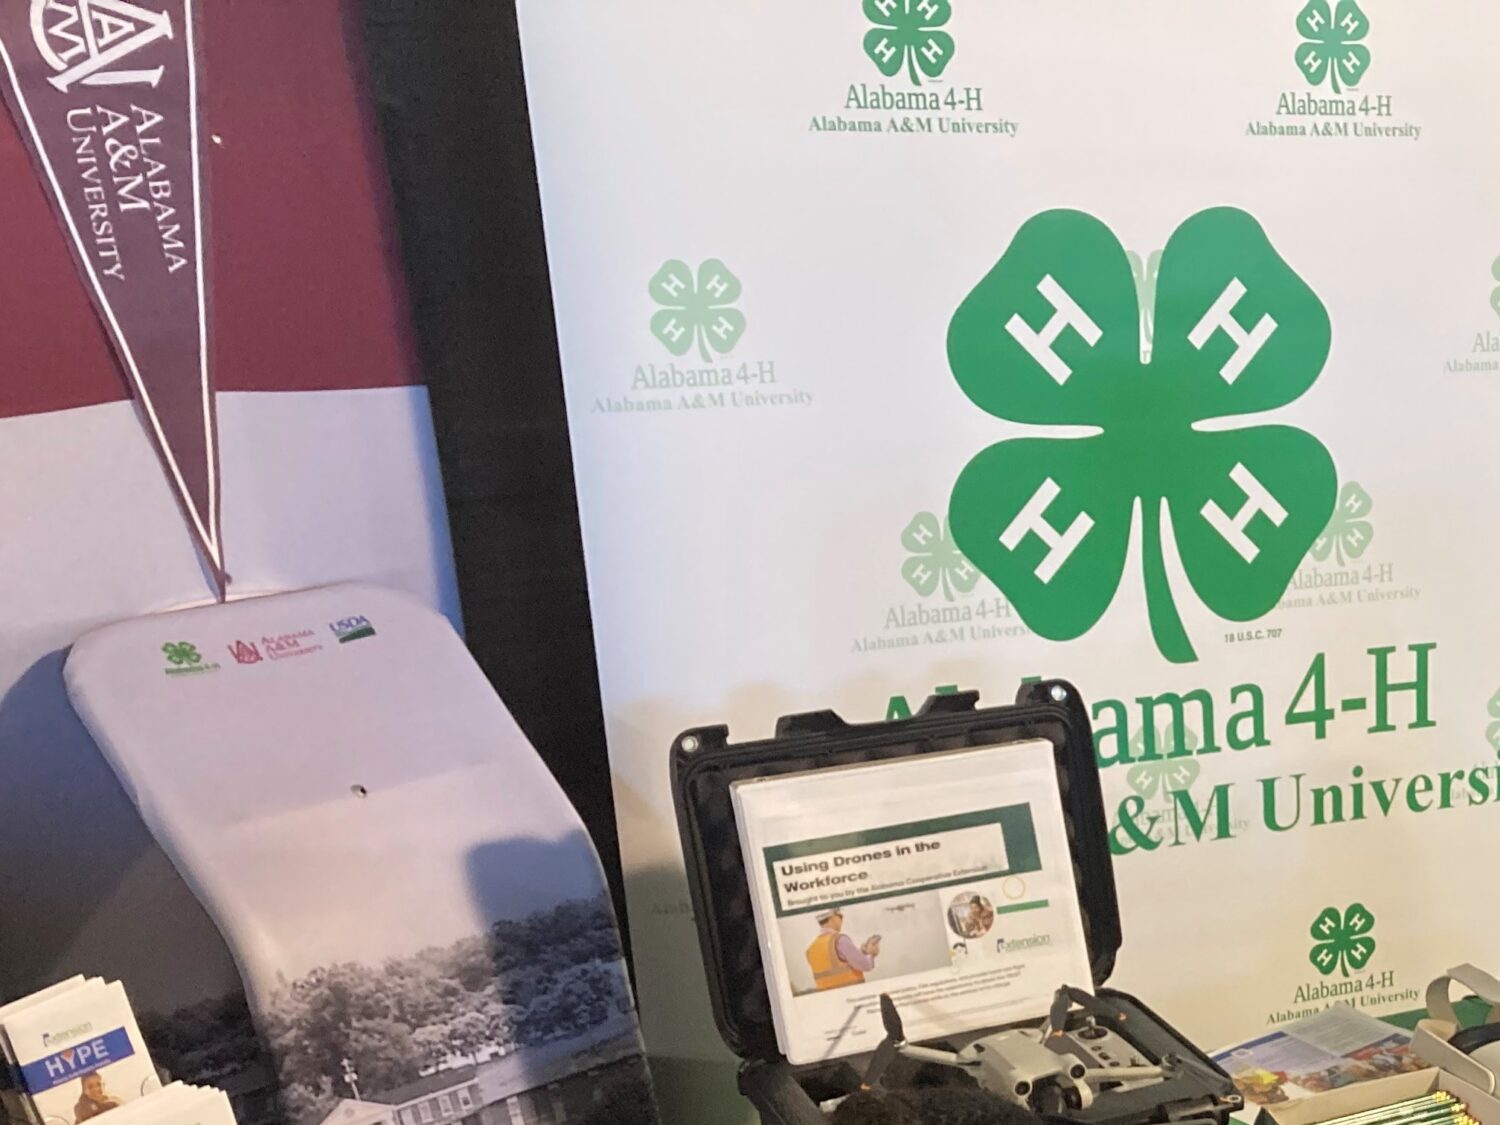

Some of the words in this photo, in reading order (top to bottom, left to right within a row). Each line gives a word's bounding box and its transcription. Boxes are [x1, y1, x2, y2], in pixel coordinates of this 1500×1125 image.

[844, 84, 941, 110] Alabama
[944, 88, 983, 111] 4-H
[1276, 92, 1356, 115] Alabama
[1359, 95, 1392, 116] 4-H
[808, 116, 882, 133] Alabama
[886, 118, 932, 133] A&M
[939, 118, 1018, 137] University
[1246, 122, 1307, 137] Alabama
[1310, 123, 1349, 137] A&M
[1353, 123, 1421, 140] University
[97, 104, 149, 211] A&M
[67, 107, 125, 281] UNIVERSITY
[131, 103, 188, 273] ALABAMA
[1004, 273, 1103, 386] H
[1187, 276, 1278, 385] H
[631, 363, 732, 390] Alabama
[736, 361, 776, 383] 4-H
[592, 394, 672, 413] Alabama
[677, 392, 725, 410] A&M
[731, 389, 813, 407] University
[1200, 461, 1289, 564] H
[998, 477, 1095, 584] H
[1361, 563, 1393, 583] 4-H
[329, 615, 370, 634] USDA
[883, 604, 972, 629] Alabama
[975, 598, 1012, 620] 4-H
[1224, 633, 1235, 643] 18
[1237, 630, 1265, 642] U.S.C.
[1266, 628, 1282, 639] 707
[1284, 642, 1438, 740] 4-H
[1107, 783, 1237, 856] &M
[781, 857, 829, 877] Using
[833, 851, 892, 868] Drones
[896, 845, 911, 855] in
[915, 840, 941, 853] the
[784, 871, 868, 893] Workforce
[1293, 980, 1362, 1003] Alabama
[1365, 970, 1394, 990] 4-H
[1266, 1007, 1319, 1025] Alabama
[1360, 987, 1421, 1007] University
[45, 1038, 109, 1078] HYPE
